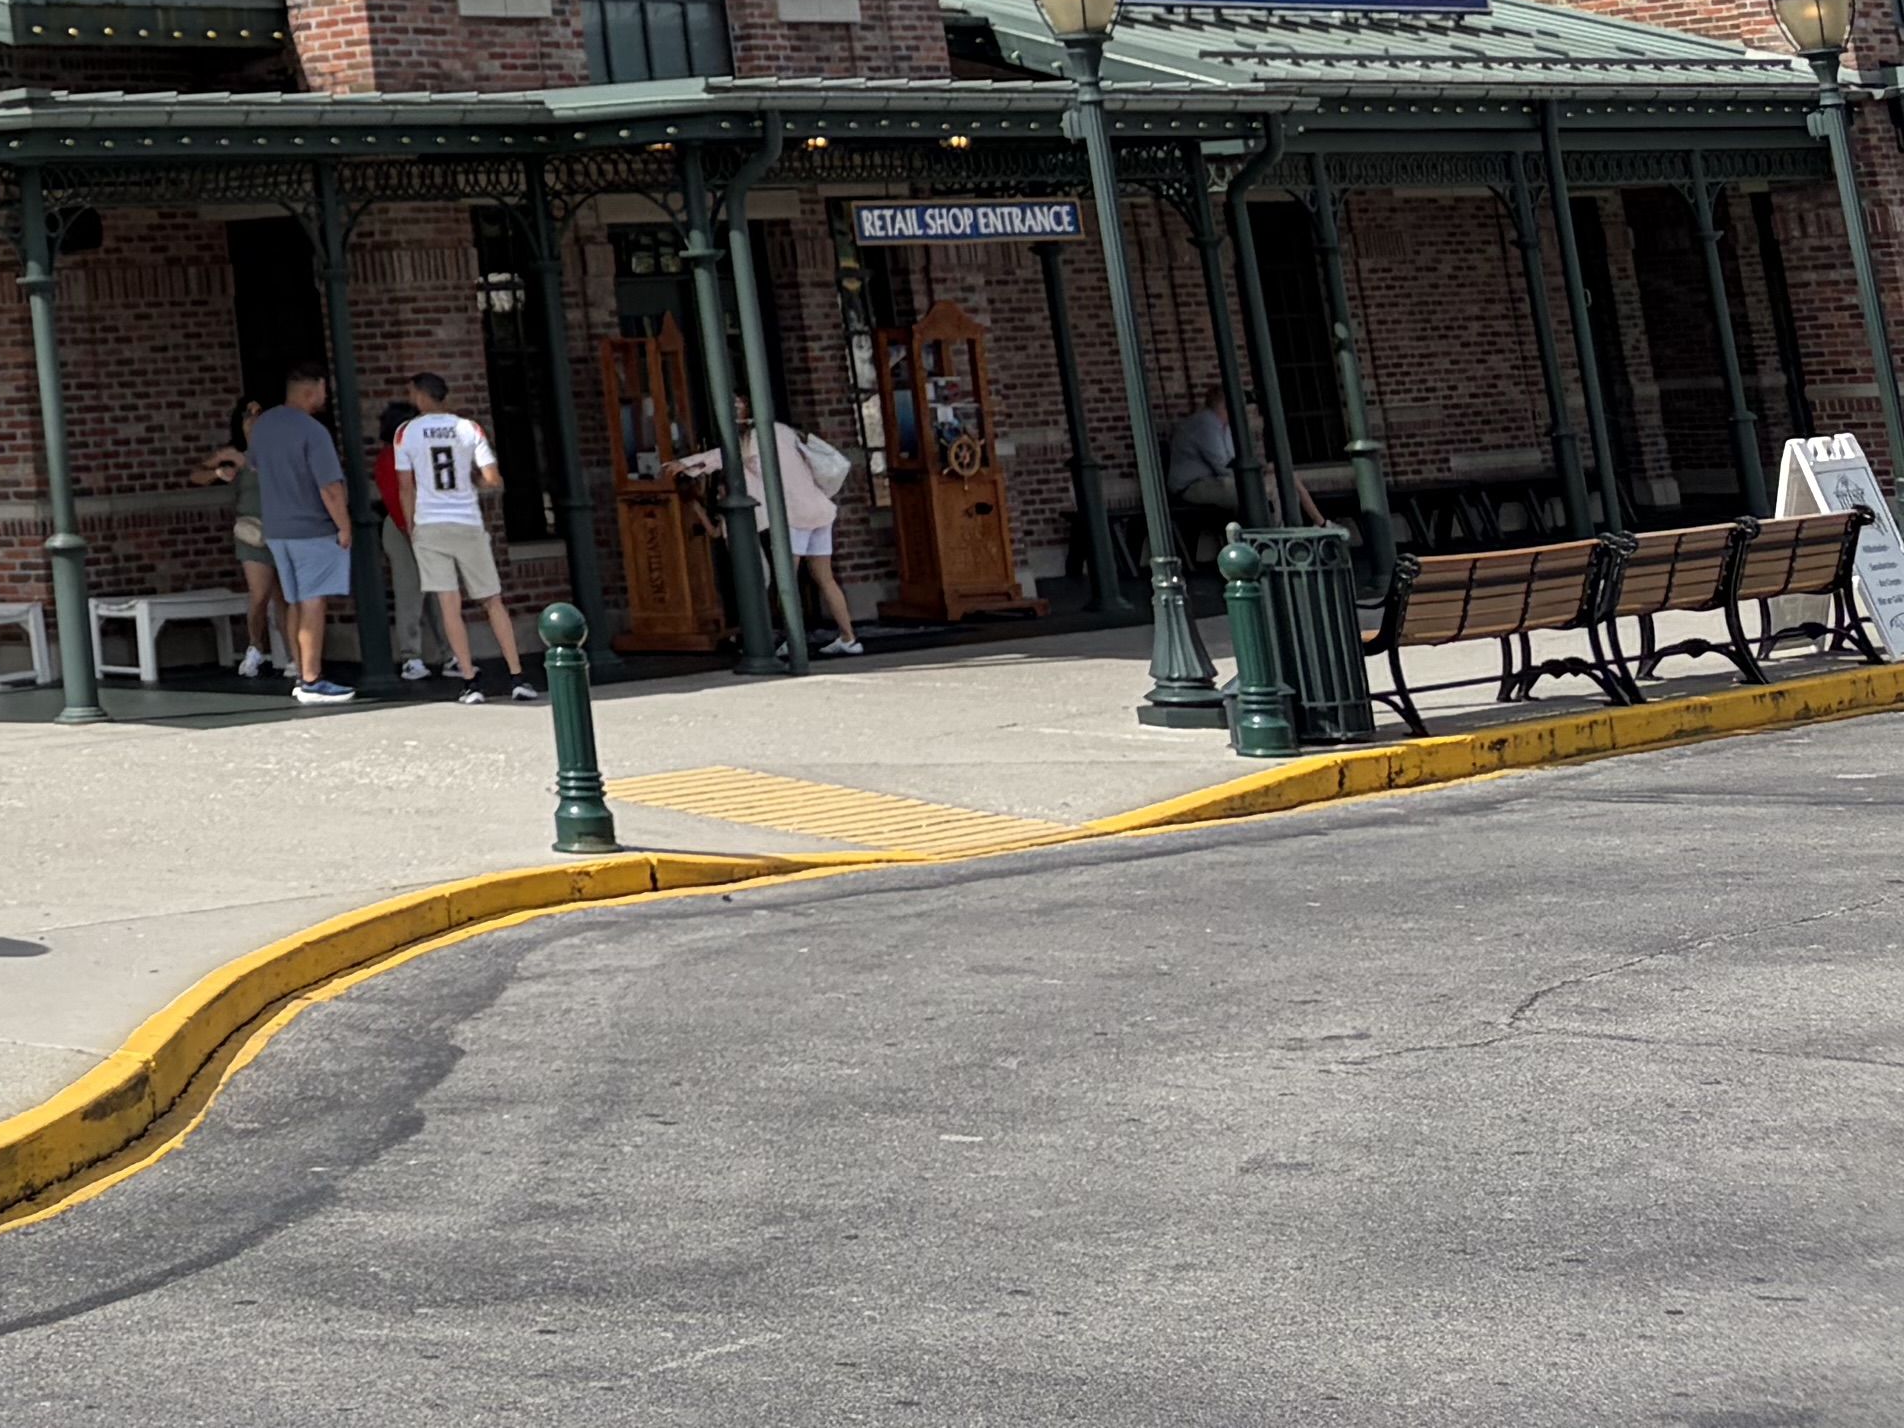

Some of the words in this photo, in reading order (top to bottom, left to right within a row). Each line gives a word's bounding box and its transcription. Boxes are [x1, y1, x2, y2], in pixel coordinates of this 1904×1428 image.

[861, 207, 923, 237] RETAIL
[924, 206, 974, 235] SHOP
[976, 205, 1075, 235] ENTRANCE
[430, 445, 456, 491] 8
